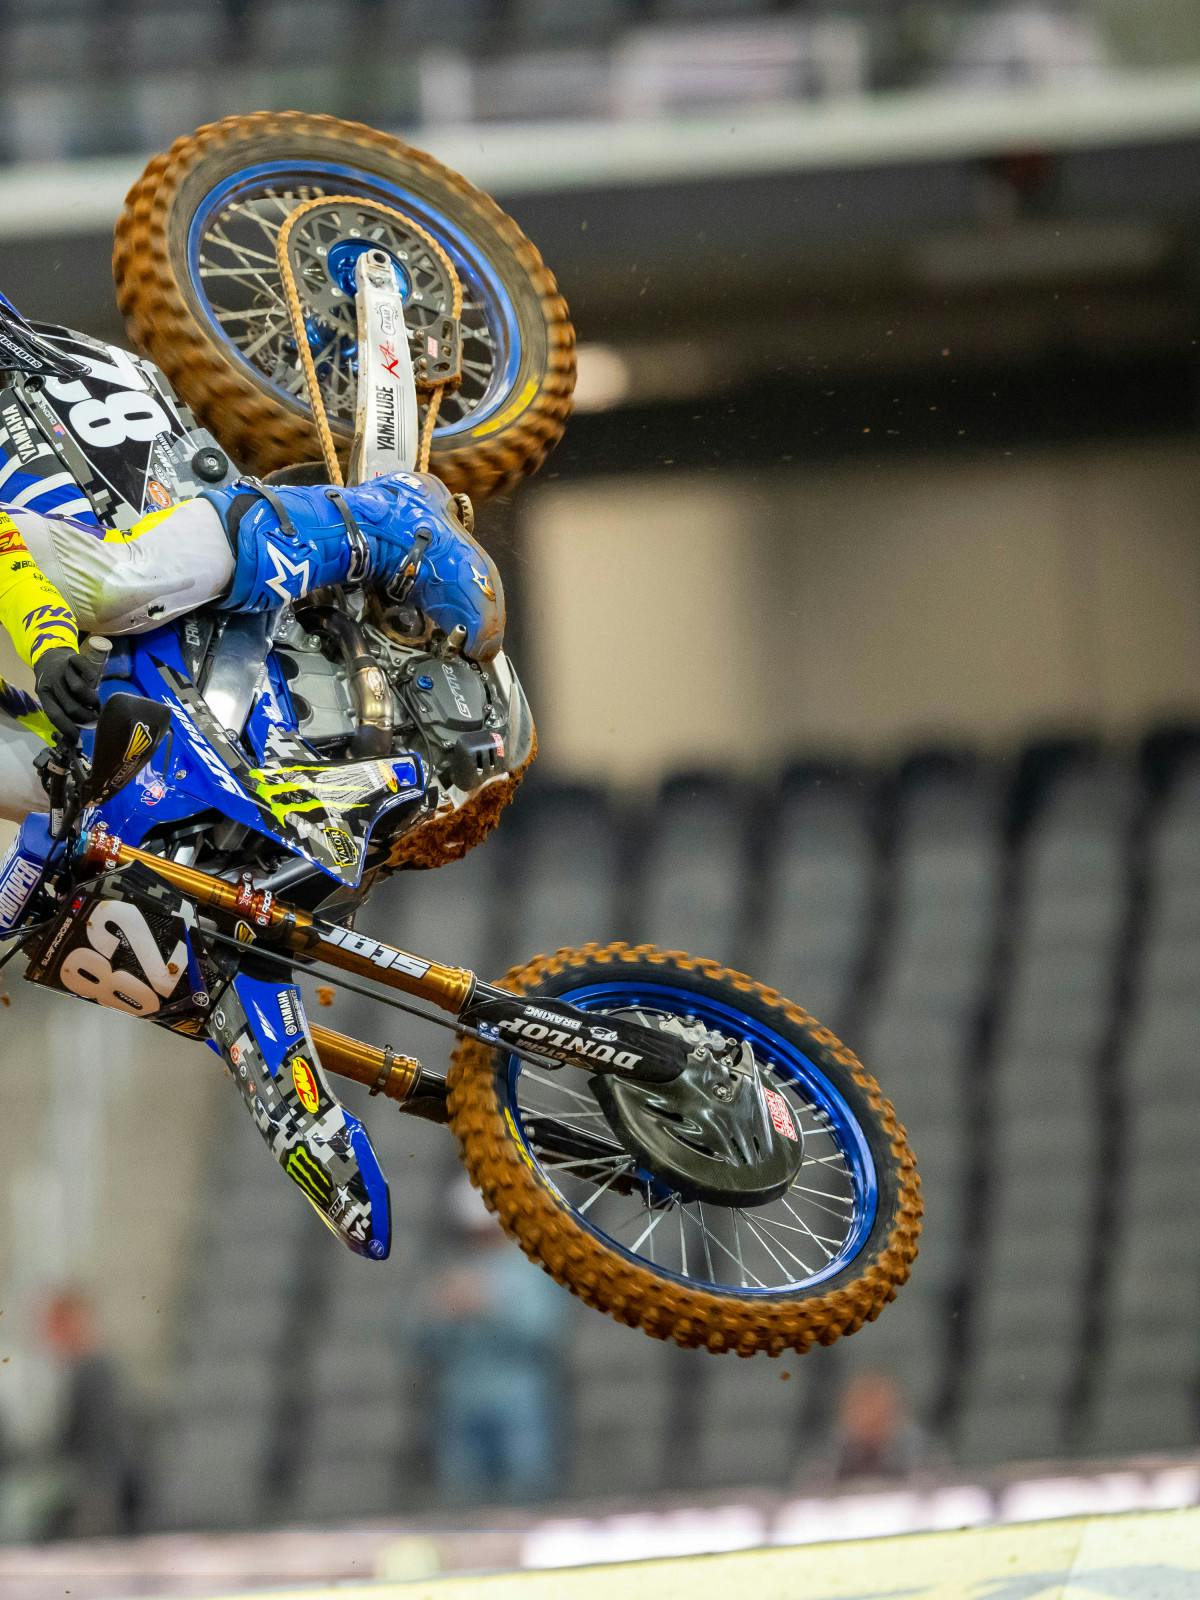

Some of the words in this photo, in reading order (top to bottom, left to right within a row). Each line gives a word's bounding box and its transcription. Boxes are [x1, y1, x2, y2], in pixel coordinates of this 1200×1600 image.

[1, 403, 38, 462] YAMAHA
[377, 386, 395, 451] YAMALUBE
[331, 829, 349, 864] VALOR
[60, 900, 189, 1017] 82
[277, 990, 297, 1026] YAMAHA
[524, 1006, 580, 1031] BRAKING
[499, 1017, 644, 1071] DUNLOP
[292, 1057, 319, 1113] FMF
